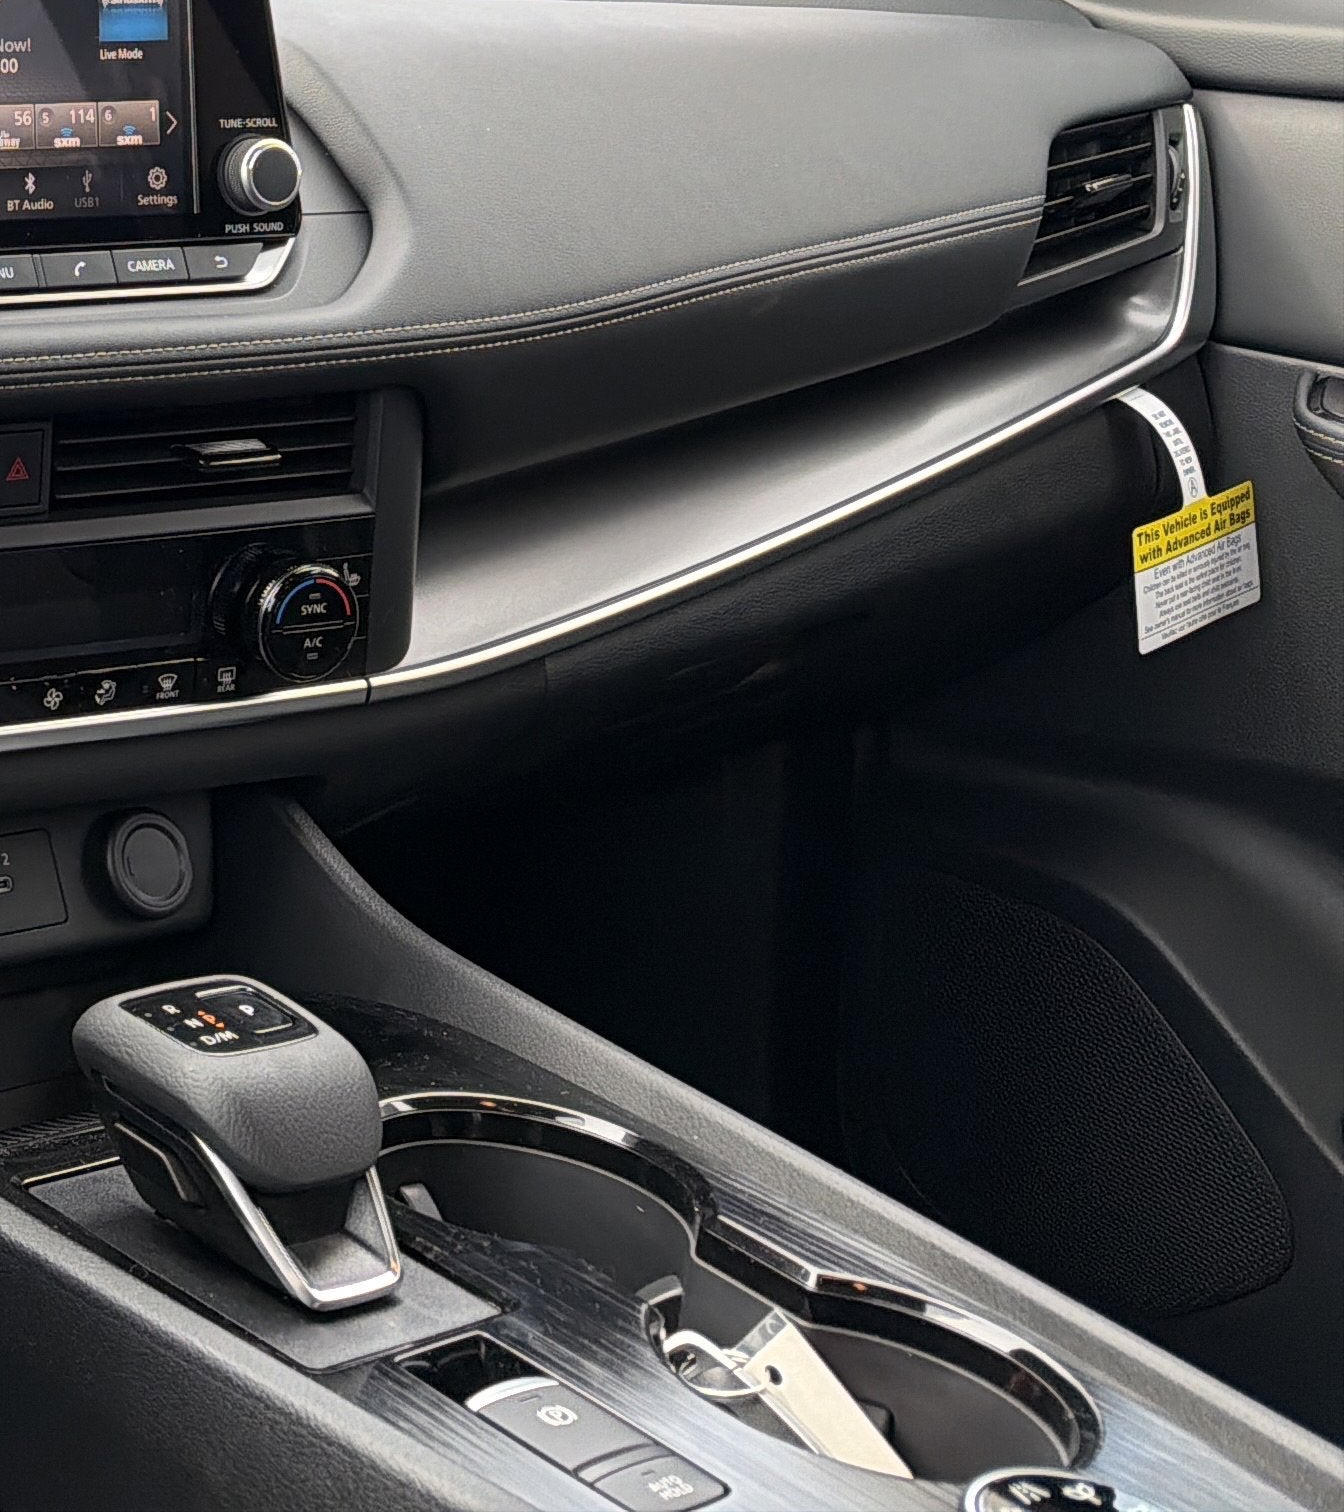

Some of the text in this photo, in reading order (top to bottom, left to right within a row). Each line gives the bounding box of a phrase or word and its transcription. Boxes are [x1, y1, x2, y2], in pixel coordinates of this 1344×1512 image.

[100, 47, 143, 60] Live Mode
[14, 110, 32, 126] 56
[42, 112, 50, 123] 5
[69, 108, 95, 124] 114
[104, 110, 112, 121] 6
[149, 106, 156, 122] 1
[54, 136, 81, 148] sxm
[116, 134, 143, 146] sxm
[7, 198, 54, 212] BT Audio
[74, 196, 100, 208] USB1
[137, 194, 178, 208] Settings
[225, 221, 284, 233] PUSH SOUND
[127, 258, 175, 272] CAMERA
[1137, 486, 1251, 547] This Vehicle is Equipped
[1139, 508, 1250, 565] with Advanced Air Bags
[301, 602, 328, 616] SYNC
[303, 636, 324, 649] A/C
[155, 689, 180, 700] FRONT
[0, 852, 11, 866] 2
[161, 1004, 181, 1015] R
[238, 1004, 255, 1016] P
[183, 1018, 204, 1028] N
[199, 1030, 240, 1046] D/M
[648, 1475, 683, 1493] AUTO
[659, 1483, 694, 1500] HOLD
